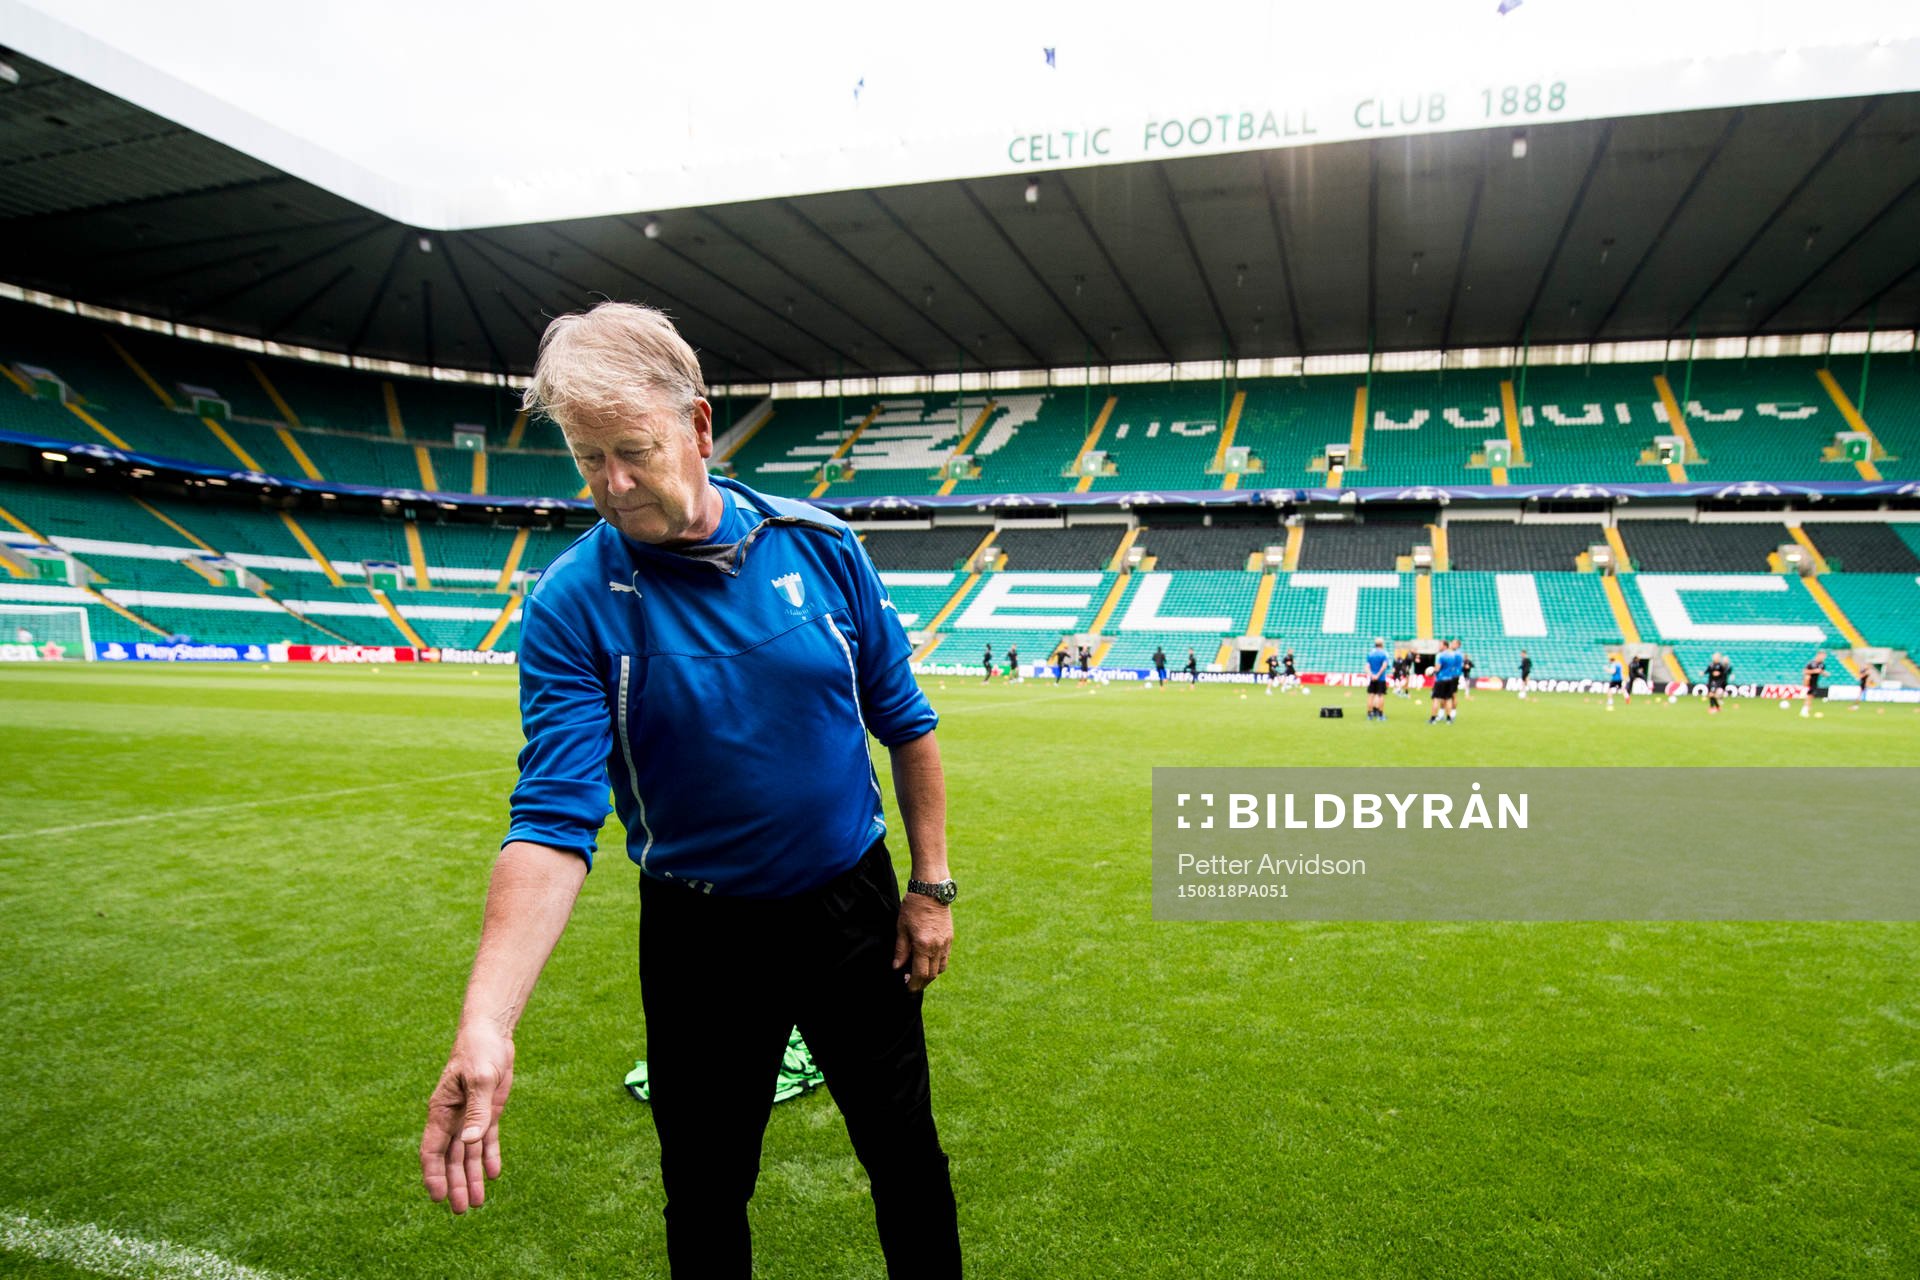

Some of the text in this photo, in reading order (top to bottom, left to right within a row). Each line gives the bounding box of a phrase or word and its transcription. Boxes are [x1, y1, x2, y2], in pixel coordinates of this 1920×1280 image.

[1008, 81, 1568, 164] CELTIC FOOTBALL CLUB 1888
[136, 642, 239, 662] PlayStation
[329, 645, 396, 662] UniCredit
[441, 648, 517, 664] MasterCard
